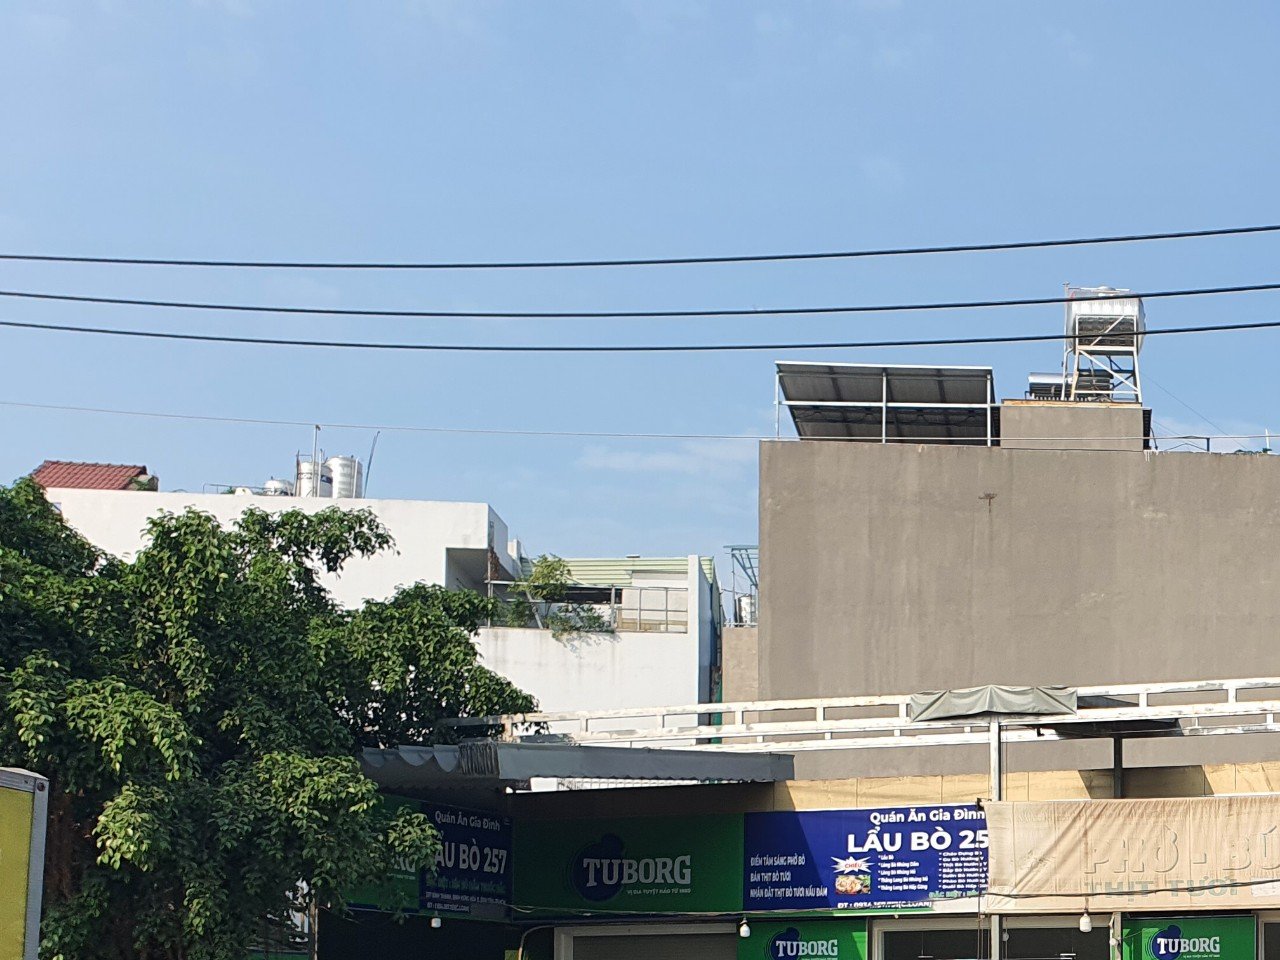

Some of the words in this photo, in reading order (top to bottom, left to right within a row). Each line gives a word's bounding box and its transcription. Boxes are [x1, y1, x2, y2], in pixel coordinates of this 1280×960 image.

[434, 810, 456, 824] Quán
[457, 811, 467, 826] Ăn
[469, 815, 481, 828] Gia
[482, 818, 500, 831] Đình
[870, 810, 905, 825] Quán
[908, 808, 926, 822] Ăn
[929, 808, 951, 821] Gia
[847, 826, 902, 853] LẨU
[910, 826, 952, 851] BÒ
[958, 829, 989, 849] 25
[459, 838, 480, 871] BÒ
[483, 847, 507, 874] 257
[583, 854, 691, 887] TUBORG
[1085, 879, 1155, 903] THỊT
[775, 939, 838, 957] TUBORG
[1156, 936, 1220, 955] TUBORG
